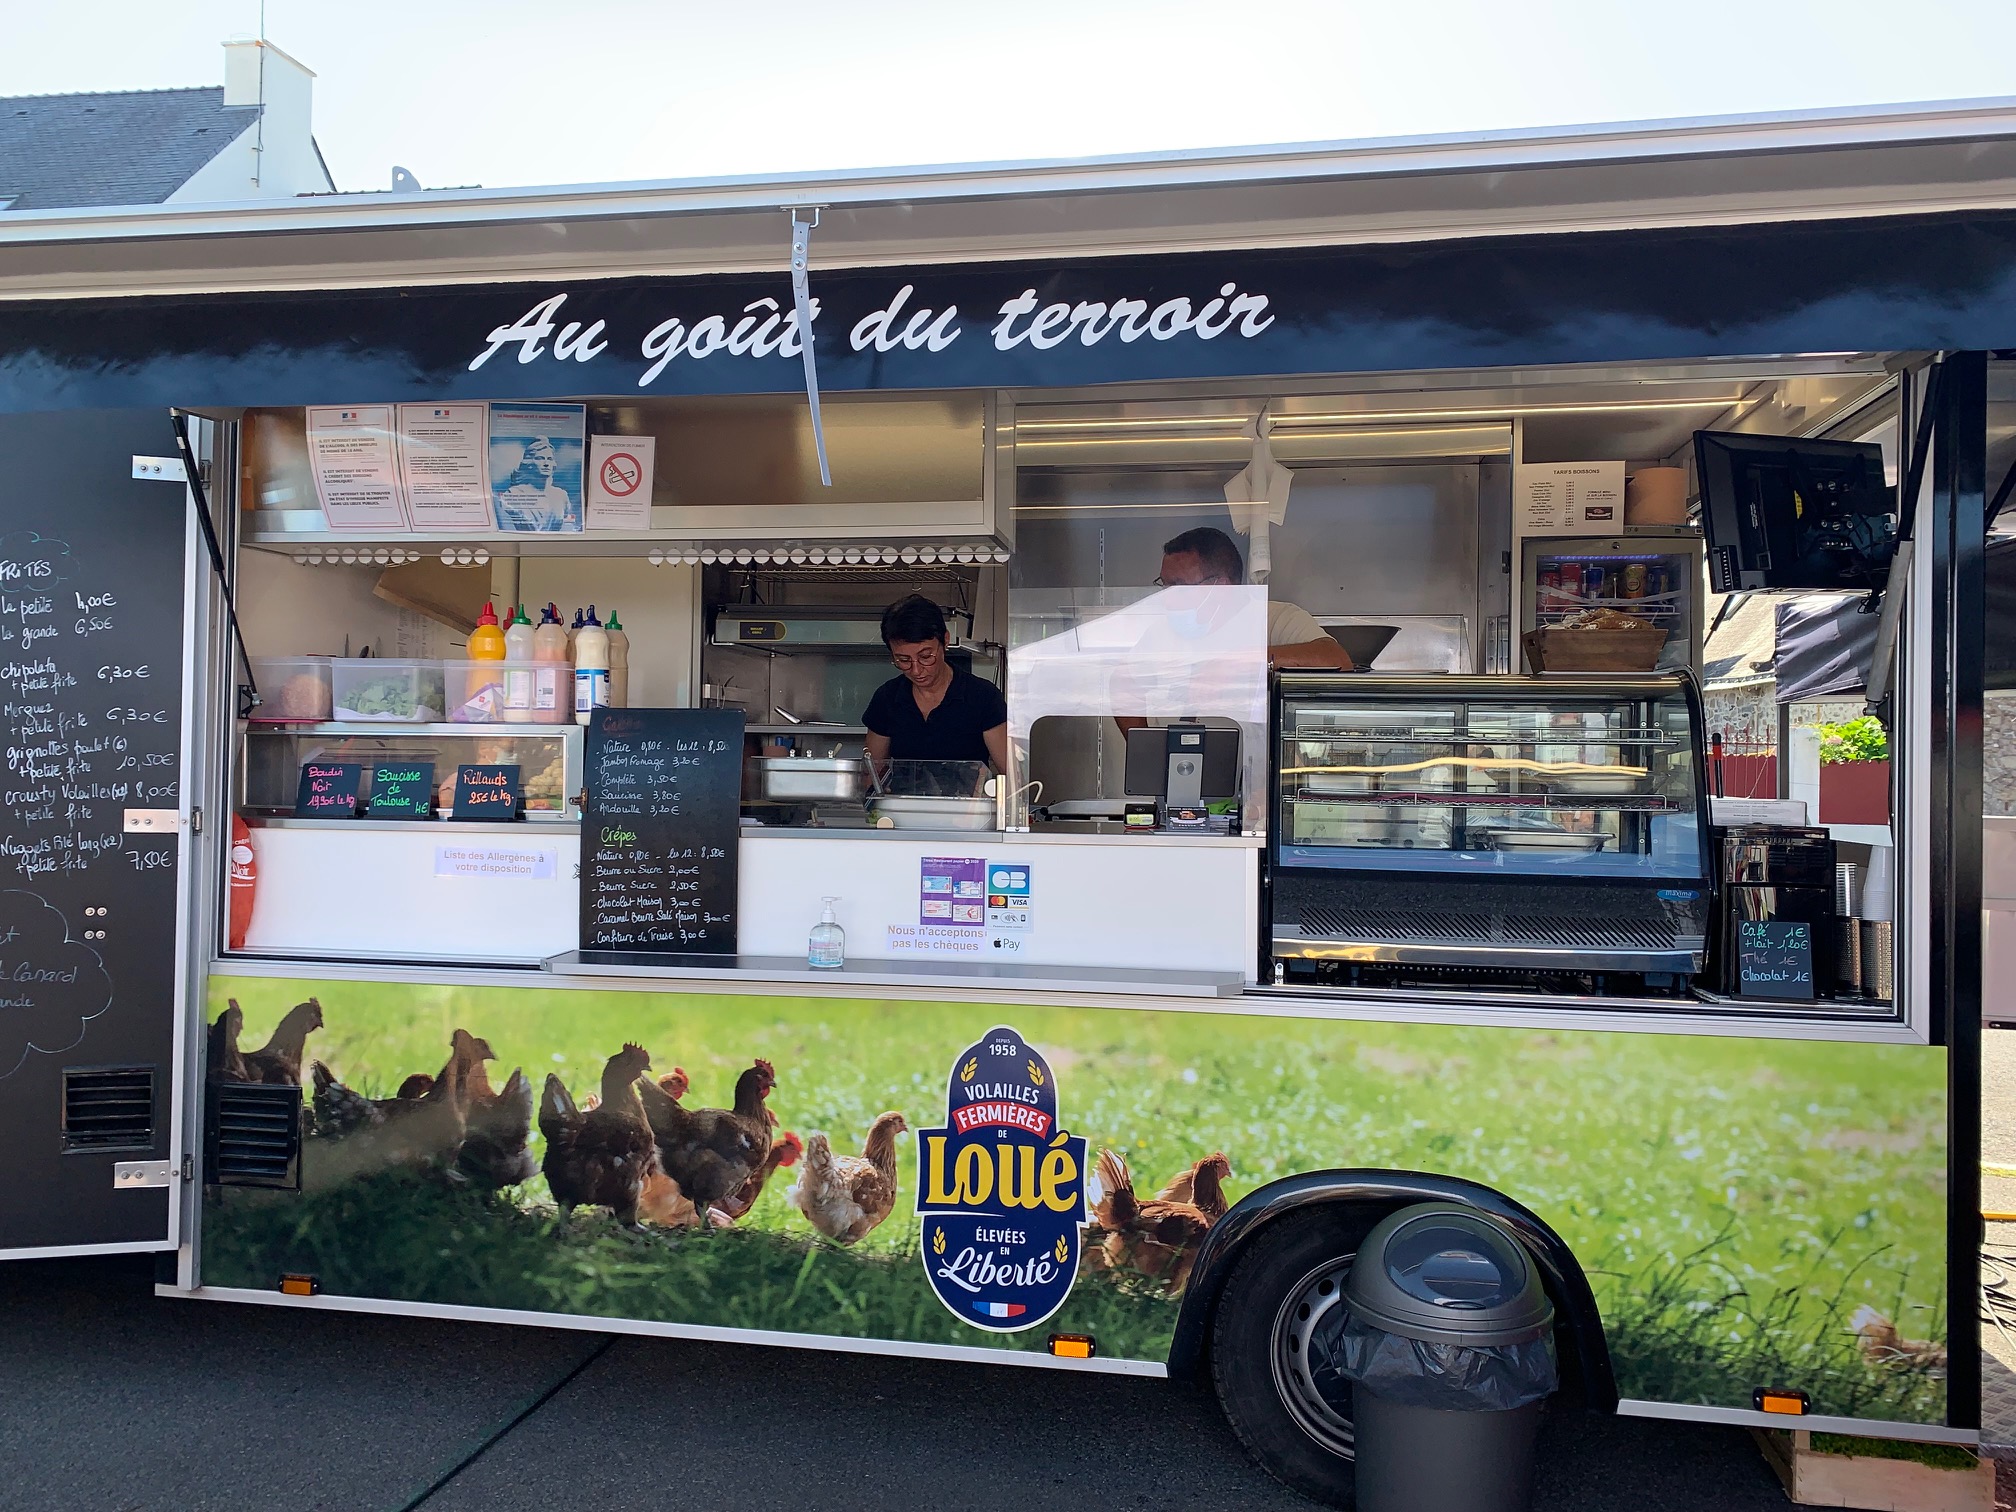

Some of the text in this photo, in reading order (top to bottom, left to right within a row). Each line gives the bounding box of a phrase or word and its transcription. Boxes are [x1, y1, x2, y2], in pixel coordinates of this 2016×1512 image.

[468, 283, 1275, 386] Au goût du terroir
[20, 597, 53, 624] petite
[75, 592, 116, 614] 4,00€
[22, 625, 58, 650] grande
[75, 617, 113, 637] 6,50€
[97, 665, 150, 683] 6,30€
[21, 677, 49, 698] petite
[50, 672, 77, 695] frite
[4, 702, 168, 726] Merguez 6,30€
[21, 718, 54, 744] petite
[57, 711, 88, 739] frite
[74, 736, 109, 760] poulet
[603, 740, 630, 754] Nature
[66, 758, 91, 782] frite
[117, 753, 174, 771] 10,50€
[308, 766, 343, 777] Boudin
[377, 769, 421, 782] Saucisse
[463, 769, 508, 786] Rillauds
[136, 782, 178, 803] 8,00€
[312, 779, 332, 792] Noir
[387, 782, 401, 795] de
[337, 794, 345, 805] le
[346, 793, 355, 808] kg
[370, 793, 411, 807] Toulouse
[468, 791, 489, 804] 25€
[490, 789, 498, 802] le
[600, 789, 681, 803] Saucisse 3,80€
[414, 801, 428, 814] 4€
[600, 803, 680, 817] Andouille 3,20€
[25, 807, 54, 829] petite
[64, 802, 93, 830] frite
[601, 825, 637, 848] Crêpes
[0, 835, 51, 865] Nuggets
[444, 851, 545, 863] Liste des Allergènes à
[597, 848, 623, 860] Nature
[26, 857, 58, 881] petite
[60, 850, 88, 877] frite
[125, 850, 172, 870] 7,50€
[455, 863, 531, 874] votre disposition
[596, 865, 621, 877] Beurre
[638, 865, 663, 874] Sucre
[669, 865, 700, 877] 2,00€
[599, 881, 698, 892] Beurre Sucre 2,50€
[637, 895, 662, 909] Maison
[671, 897, 701, 909] 3,00€
[631, 912, 655, 924] Beurre
[656, 910, 672, 921] Salé
[888, 925, 915, 936] Nous
[919, 926, 983, 939] n'acceptons
[1742, 922, 1806, 939] Café 1€
[597, 929, 634, 949] Confiture
[638, 932, 647, 942] de
[680, 929, 707, 944] 3,00€
[892, 939, 979, 951] pas les chèques
[1003, 938, 1021, 951] Pay
[1777, 939, 1809, 952] 1,20€
[1741, 951, 1798, 966] Thé 1€
[13, 961, 77, 983] Canard
[1792, 971, 1810, 982] 1€
[988, 1044, 1017, 1056] 1958
[964, 1083, 1040, 1105] VOLAILLES
[957, 1102, 1047, 1133] FERMIÈRES
[998, 1129, 1008, 1139] DE
[975, 1226, 1026, 1245] ÉLEVÉES
[1000, 1246, 1010, 1256] EN
[937, 1246, 1059, 1293] Liberté
